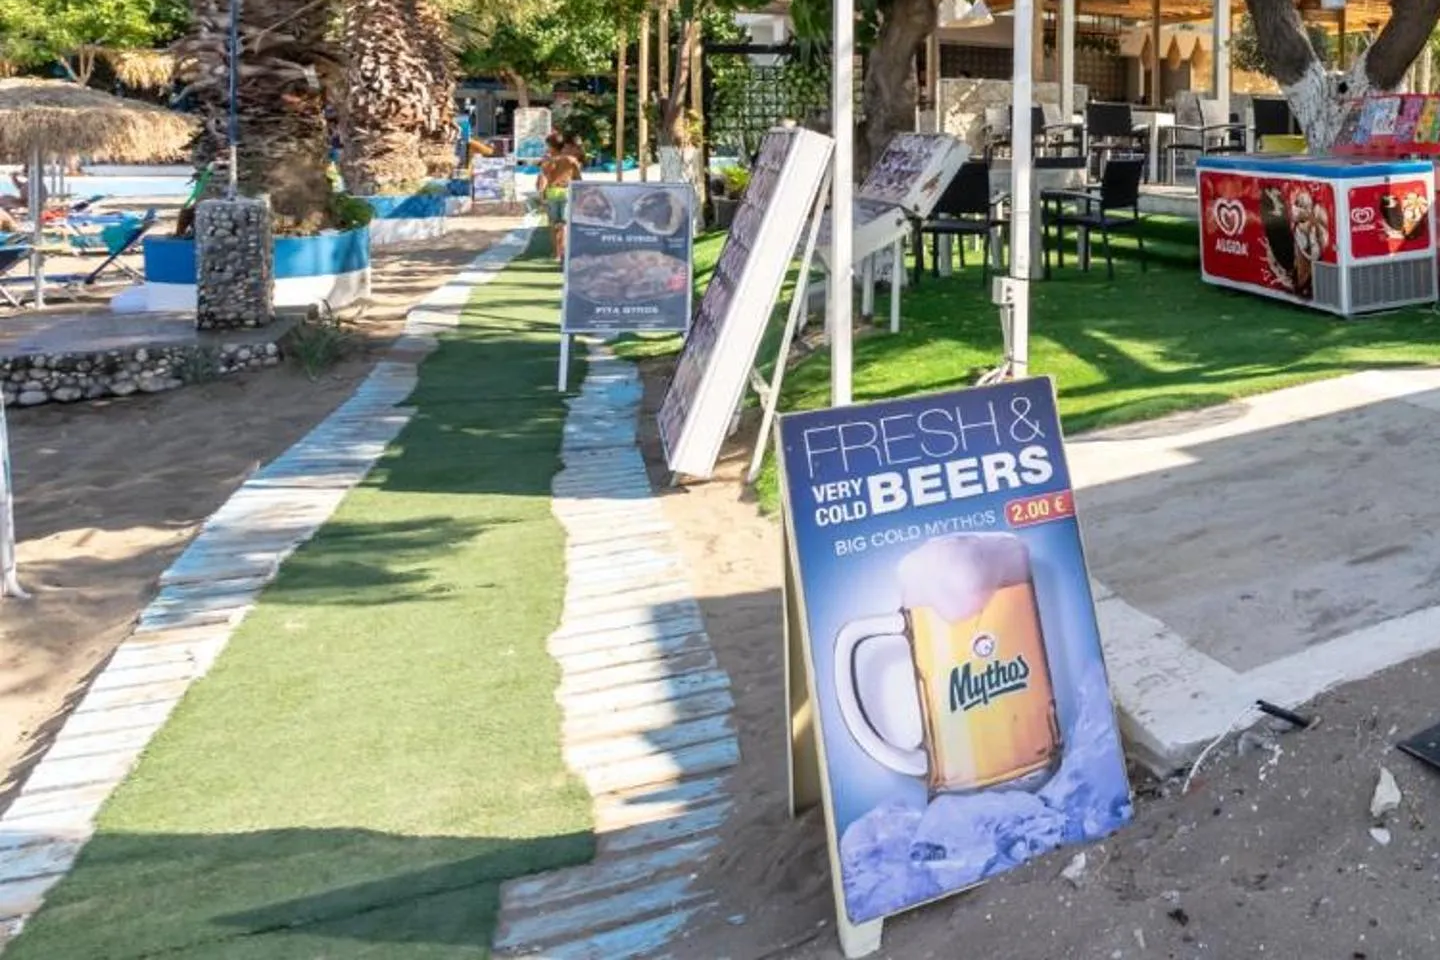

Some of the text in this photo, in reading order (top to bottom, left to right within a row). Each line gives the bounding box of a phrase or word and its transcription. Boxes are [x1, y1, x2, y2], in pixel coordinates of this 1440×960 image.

[803, 396, 1045, 479] FRESH &
[811, 477, 865, 503] VERY
[866, 445, 1053, 515] BEERS
[815, 501, 867, 526] COLD
[1011, 497, 1068, 522] 2.00 €
[834, 510, 996, 556] BIG COLD MYTHOS
[950, 654, 1030, 713] Mythos
